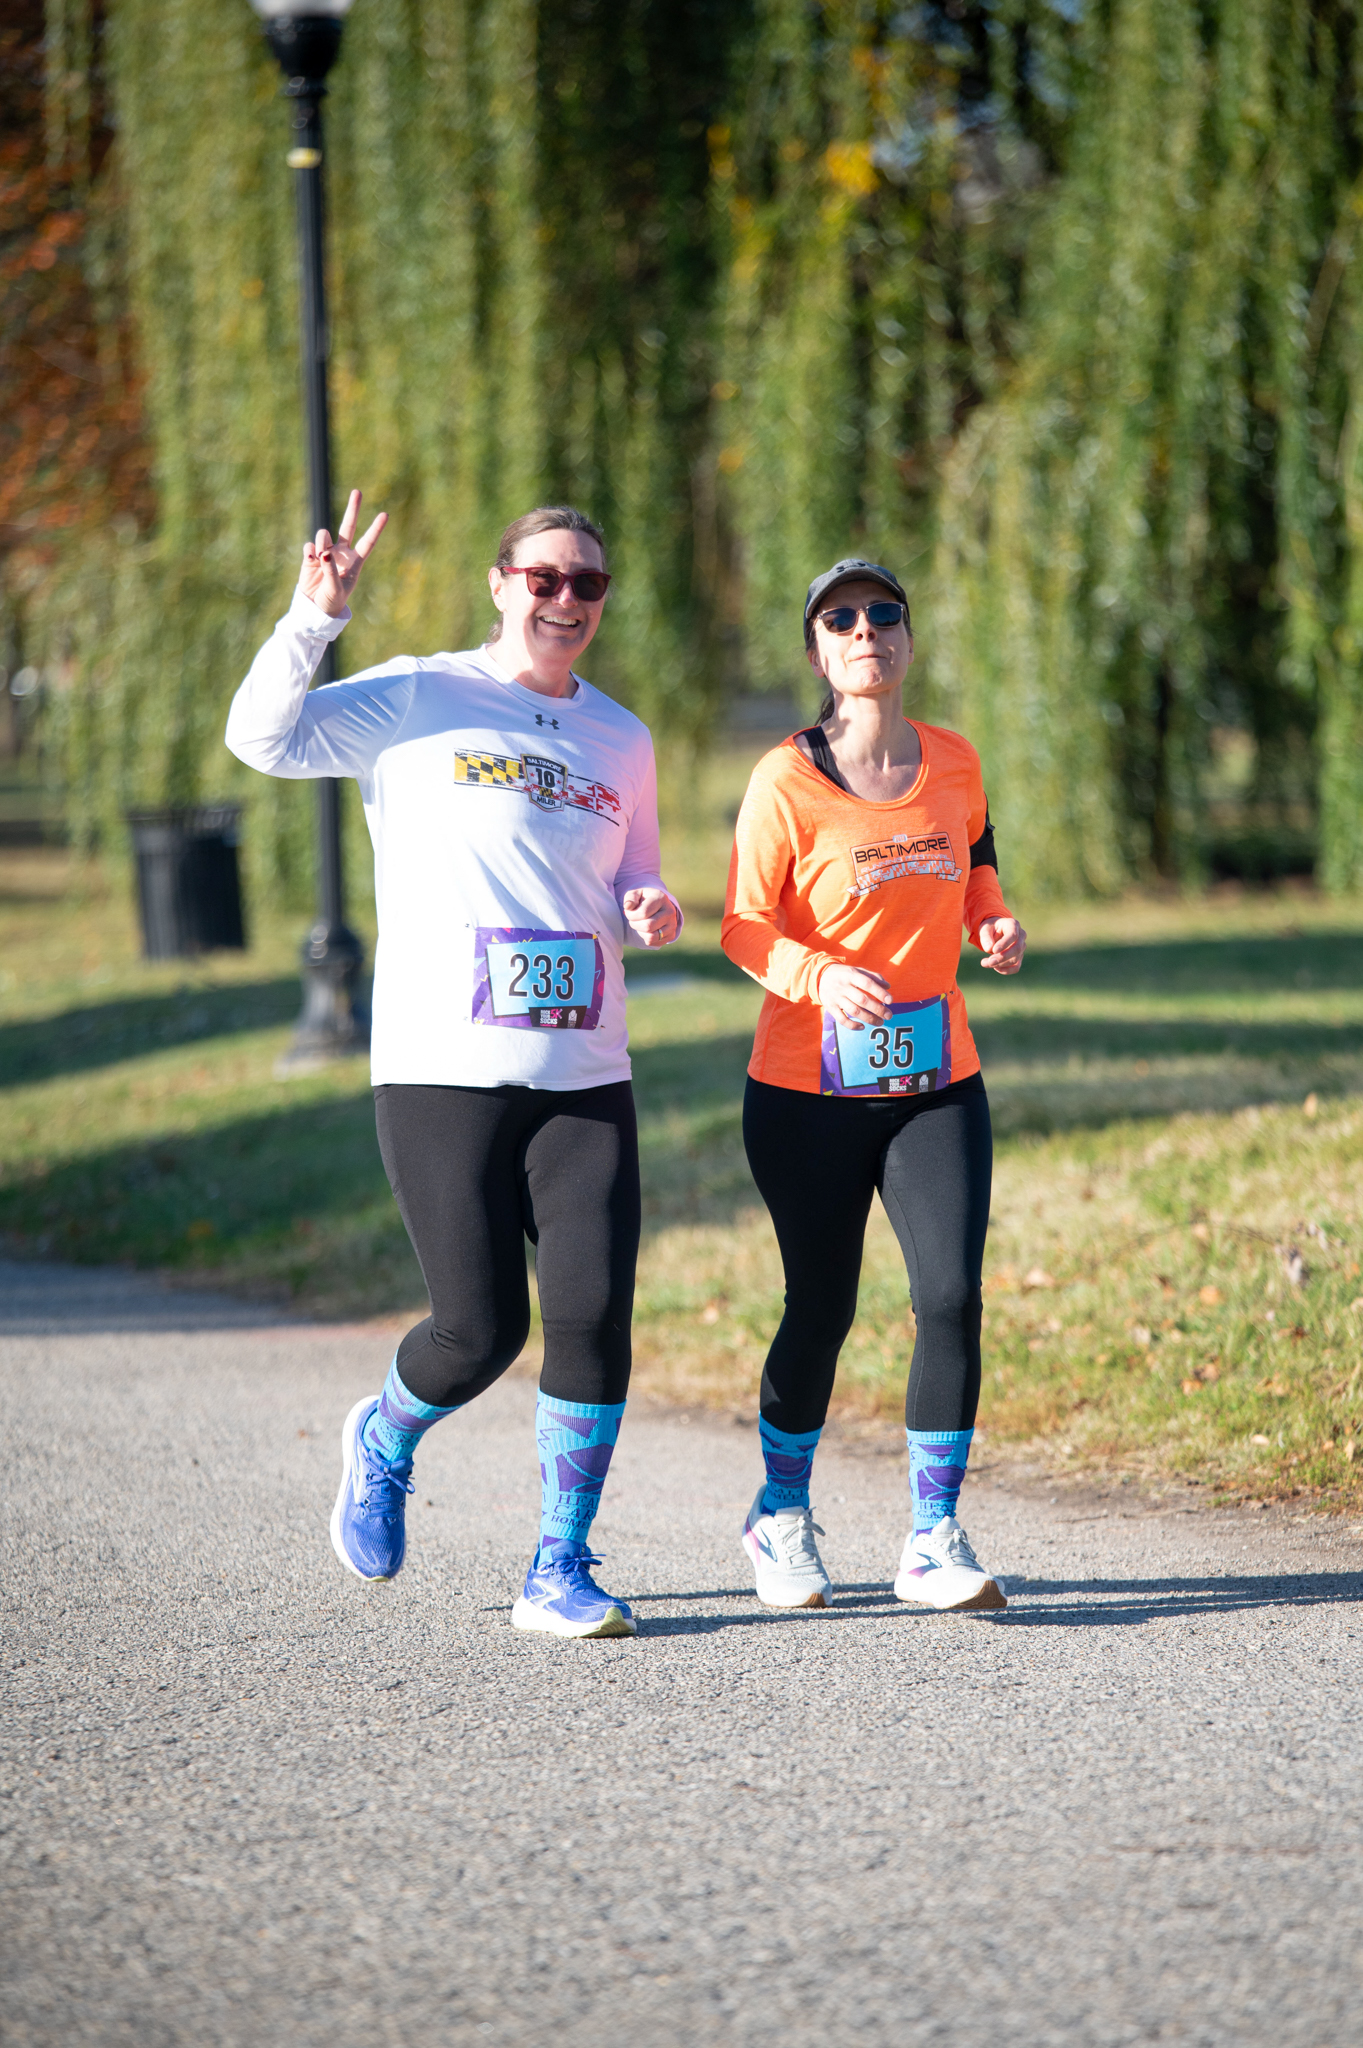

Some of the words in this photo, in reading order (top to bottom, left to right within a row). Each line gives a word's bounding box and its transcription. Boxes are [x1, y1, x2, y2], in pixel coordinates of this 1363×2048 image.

[526, 757, 563, 773] BALTIMORE
[535, 767, 556, 788] 10
[536, 795, 556, 806] MILER
[854, 837, 950, 863] BALTIMORE
[860, 857, 903, 874] RUNNING
[905, 853, 951, 861] FESTIVAL
[508, 953, 575, 1001] 233
[550, 1008, 563, 1019] 5K
[868, 1025, 914, 1070] 35
[899, 1075, 913, 1086] 5K
